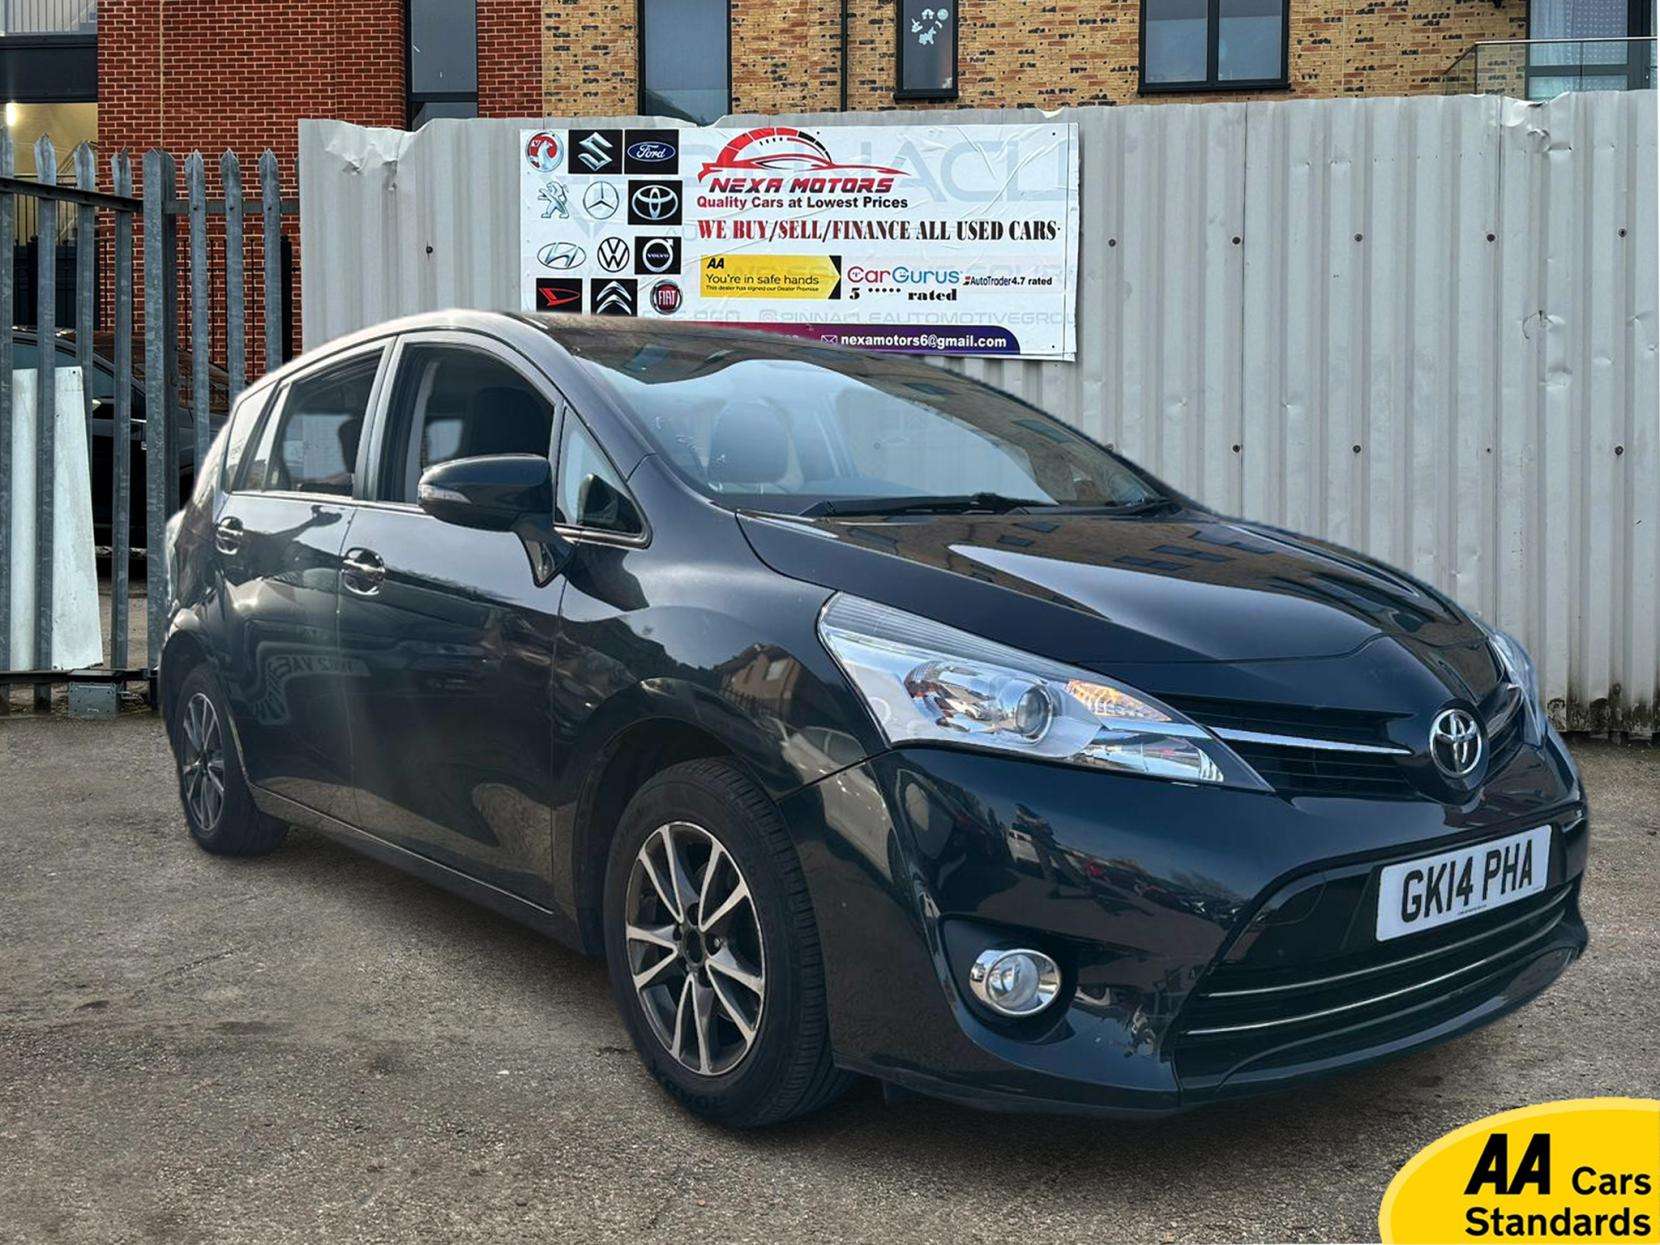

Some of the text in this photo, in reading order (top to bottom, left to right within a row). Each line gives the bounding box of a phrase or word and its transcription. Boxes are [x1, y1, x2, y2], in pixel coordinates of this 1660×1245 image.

[636, 144, 666, 159] Ford
[709, 178, 894, 193] NEXA MOTORS
[697, 196, 908, 210] Quality Cars at Lowest Prices
[697, 220, 727, 240] WE
[732, 220, 910, 242] BUY/SELL/FINANCE
[916, 221, 950, 240] ALL
[956, 221, 1004, 240] USED
[1009, 220, 1057, 241] CARS
[707, 258, 725, 269] AA
[706, 274, 819, 285] You're in safe hands
[847, 266, 960, 284] CarGurus
[1028, 277, 1053, 286] rated
[658, 290, 676, 306] FIAT
[849, 287, 958, 301] 5 rated
[841, 334, 1007, 349] nexamotors6@gmail.com
[1401, 839, 1533, 924] GK14 PHA
